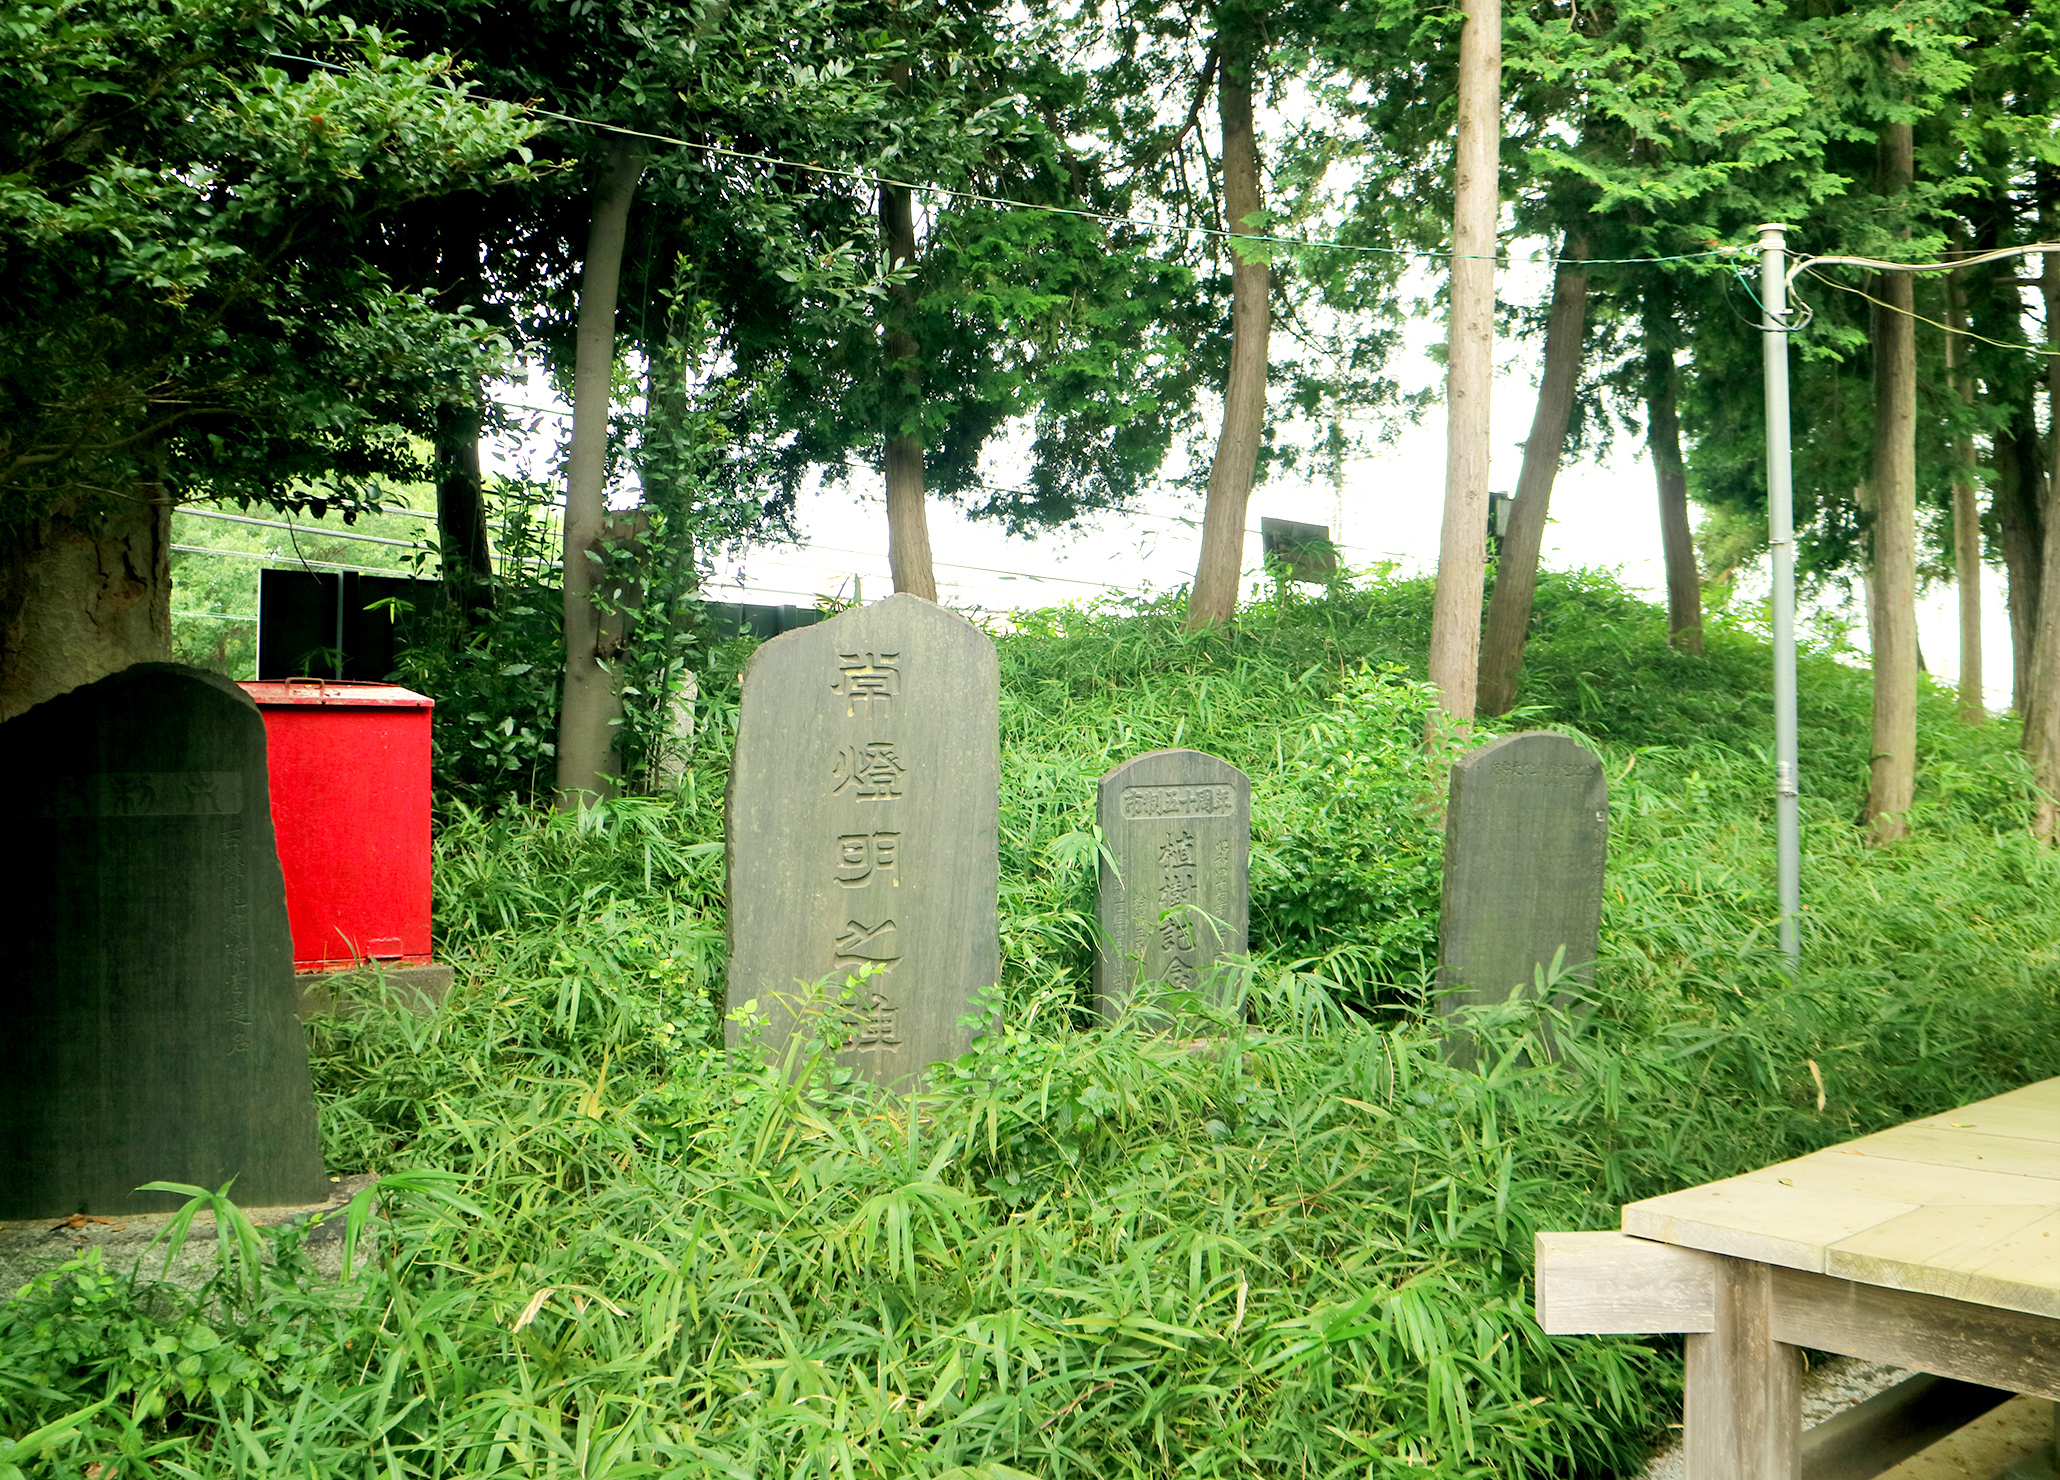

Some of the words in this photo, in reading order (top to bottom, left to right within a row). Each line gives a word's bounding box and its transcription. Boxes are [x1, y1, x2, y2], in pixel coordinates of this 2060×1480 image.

[1124, 787, 1233, 816] 市制五十周年
